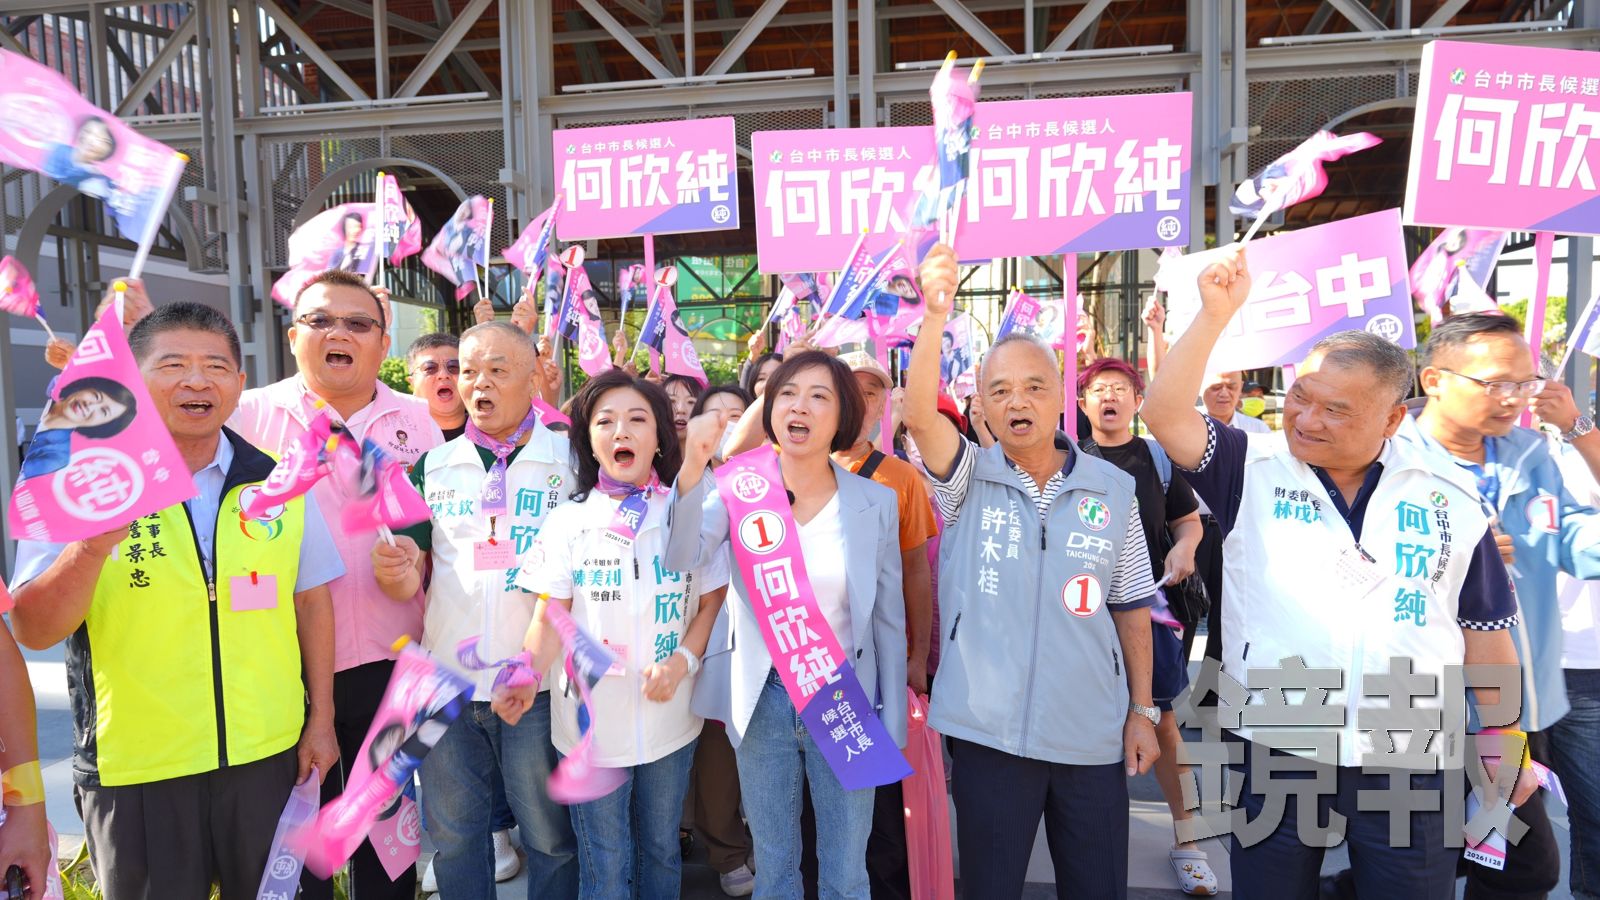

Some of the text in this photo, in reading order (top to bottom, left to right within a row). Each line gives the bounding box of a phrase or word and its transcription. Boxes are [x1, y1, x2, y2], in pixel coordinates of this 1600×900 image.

[1474, 69, 1600, 97] 台中市長候選
[988, 118, 1116, 140] 台中市長候選人
[1433, 94, 1600, 191] 何欣
[580, 135, 676, 155] 台中市長候選人
[789, 143, 912, 164] 台中市長候選人
[561, 149, 730, 212] 何欣純
[967, 137, 1183, 224] 何欣純
[712, 206, 729, 222] 純
[1159, 218, 1180, 239] 純
[565, 246, 578, 267] 1
[658, 267, 671, 285] 1
[1248, 252, 1392, 333] 台中
[1368, 316, 1401, 343] 純
[67, 456, 132, 515] 純
[736, 473, 766, 499] 純
[616, 506, 641, 530] 派
[1541, 498, 1561, 530] 1
[753, 516, 773, 548] 1
[1066, 531, 1113, 554] DPP
[978, 505, 1007, 596] 許木桂
[1066, 549, 1100, 563] TAICHUNG
[1394, 500, 1437, 627] 何欣純
[1431, 508, 1453, 596] 台中市長候選人
[572, 568, 622, 588] 陳美利
[1075, 578, 1092, 613] 1
[752, 557, 843, 700] 何欣純
[820, 710, 861, 762] 候選人
[836, 700, 874, 753] 台中市長
[1466, 850, 1502, 867] 20261128
